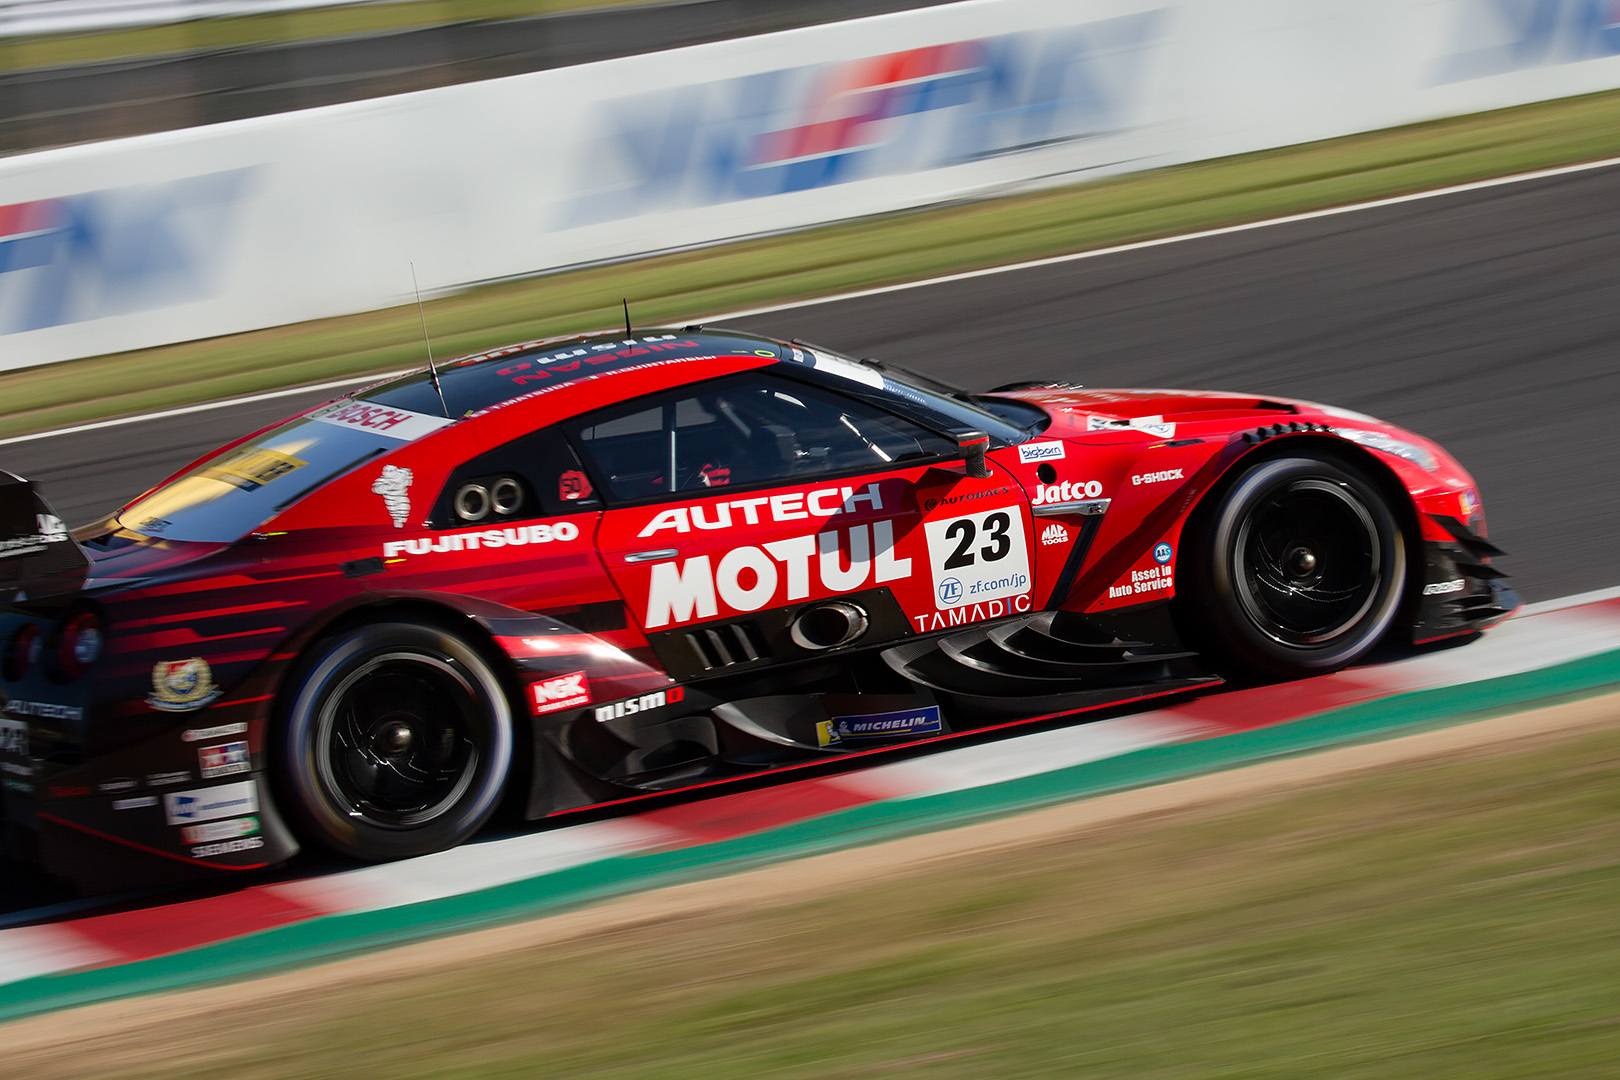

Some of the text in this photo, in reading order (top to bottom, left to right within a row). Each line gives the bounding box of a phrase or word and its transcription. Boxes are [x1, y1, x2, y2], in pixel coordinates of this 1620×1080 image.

[511, 340, 701, 386] NISSAN
[326, 404, 414, 431] BOSCH
[1021, 447, 1062, 458] bigborn
[1131, 468, 1184, 486] G-SHOCK
[939, 487, 1010, 506] AUTOBACS
[1032, 480, 1102, 505] Jatco
[637, 483, 884, 538] AUTECH
[383, 522, 579, 558] FUJITSUBO
[943, 512, 1011, 571] 23
[1041, 524, 1068, 540] MAC
[1041, 536, 1069, 546] TOOLS
[646, 519, 913, 628] MOTUL
[969, 573, 1027, 595] zf.com/jp
[1131, 565, 1172, 583] Asset in
[1109, 577, 1173, 598] Auto Service
[914, 595, 1031, 632] TAMADIC
[534, 675, 586, 703] NGK
[595, 687, 684, 723] nismo
[853, 716, 926, 732] MICHELIN
